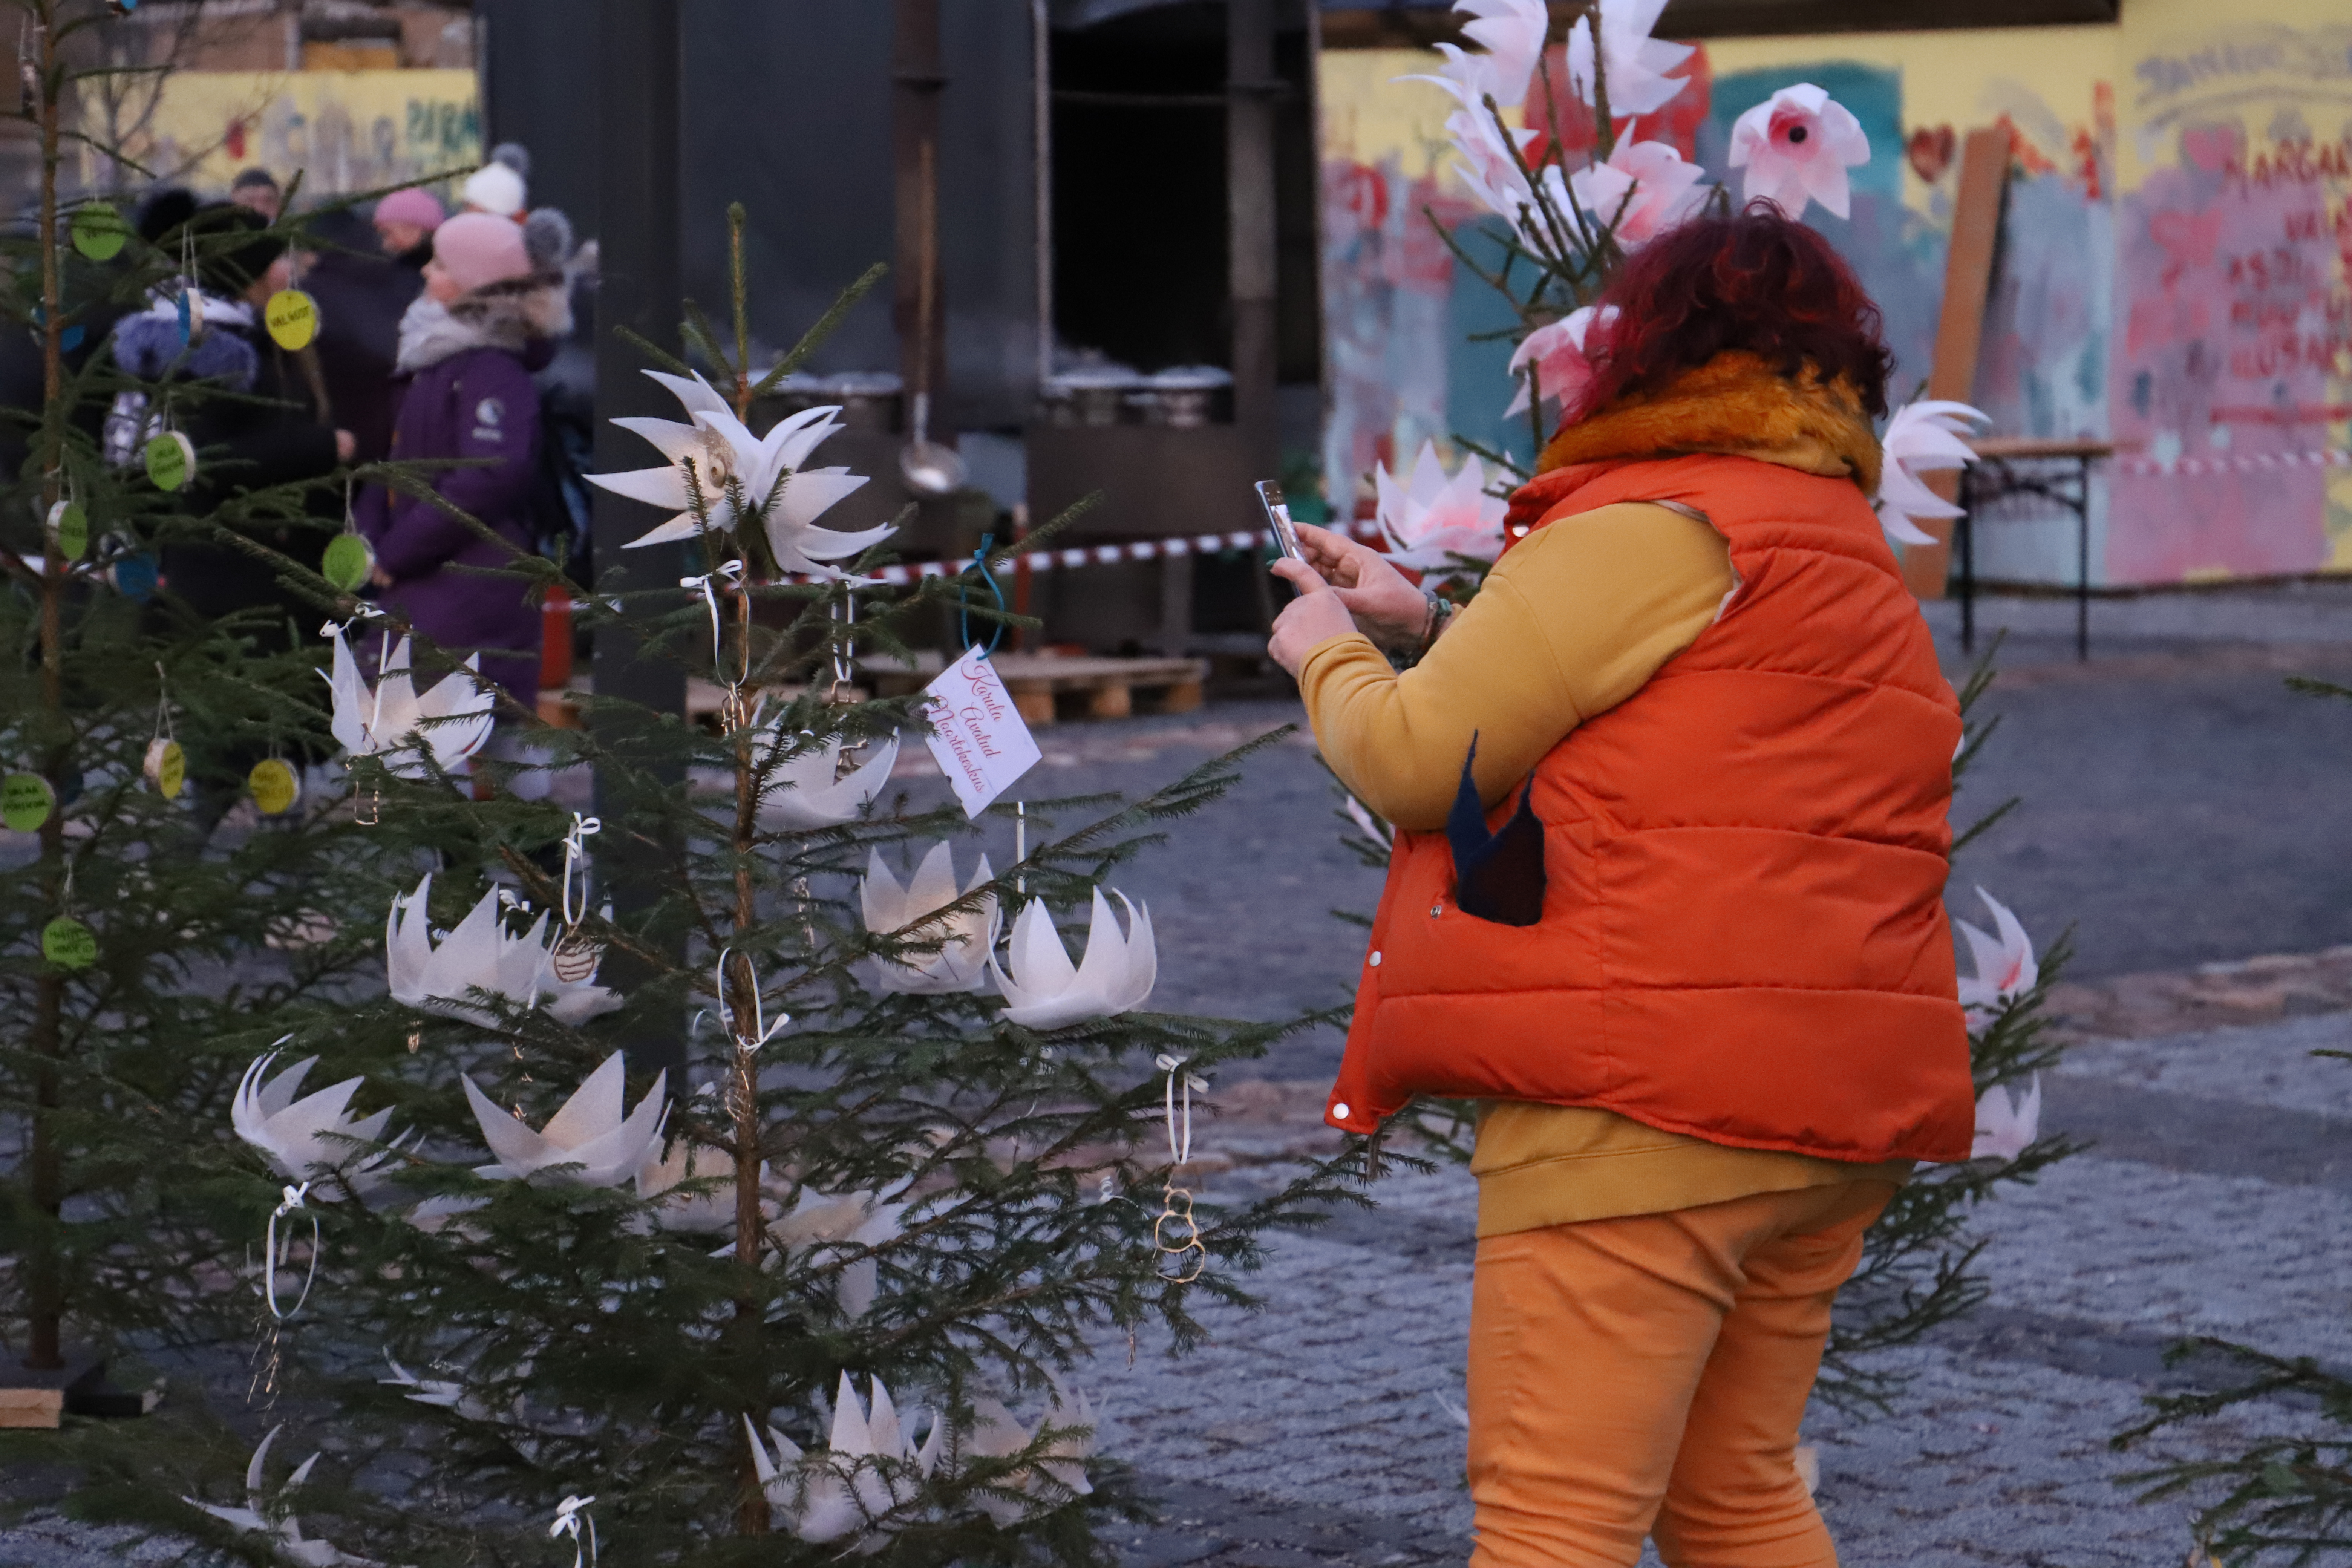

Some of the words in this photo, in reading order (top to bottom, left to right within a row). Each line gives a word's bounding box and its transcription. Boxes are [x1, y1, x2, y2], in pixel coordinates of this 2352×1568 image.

[271, 305, 309, 328] VALGUST
[961, 660, 1006, 722] Karula
[930, 695, 985, 793] Noortekeskus
[960, 701, 1002, 759] Avatud
